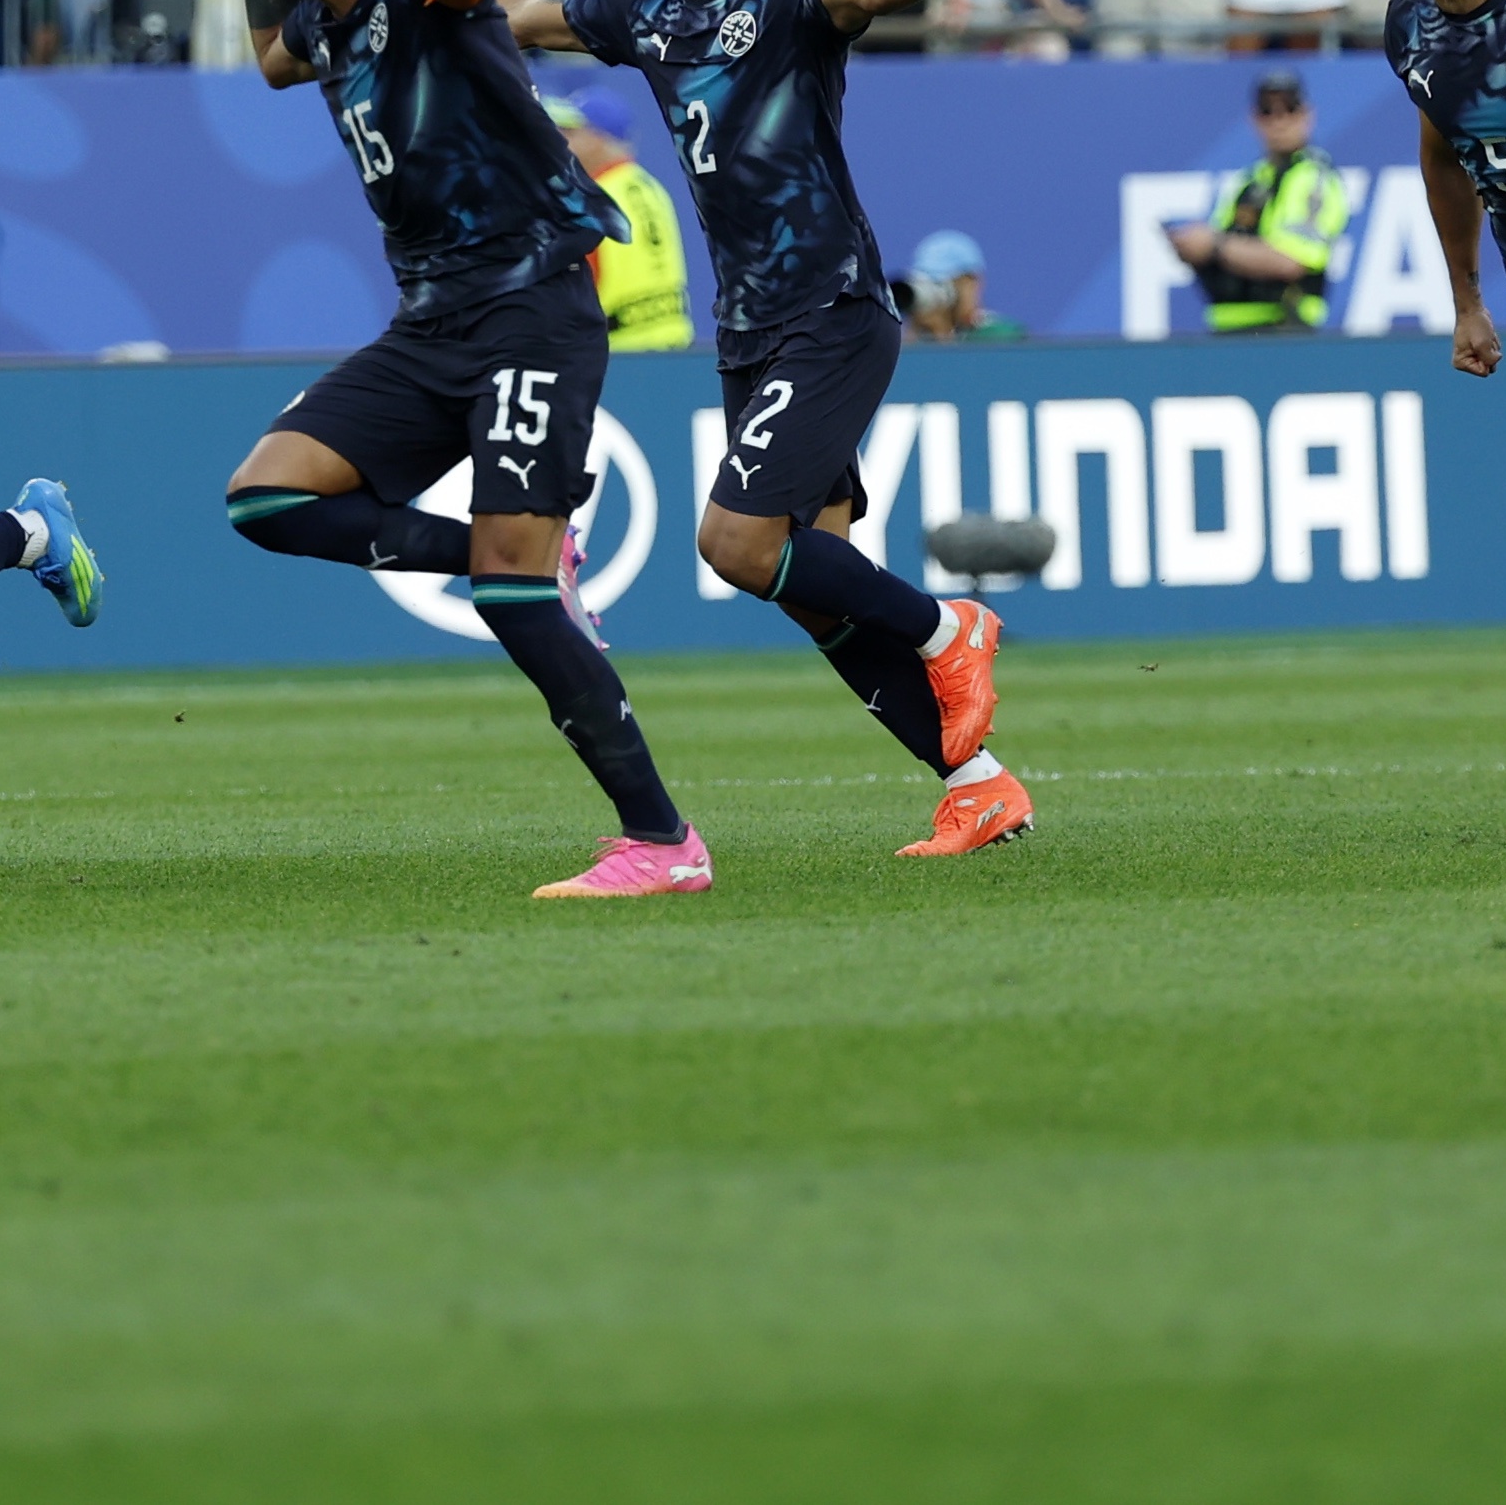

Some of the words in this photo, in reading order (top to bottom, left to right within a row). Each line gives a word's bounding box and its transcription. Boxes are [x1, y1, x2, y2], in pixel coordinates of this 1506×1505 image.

[343, 99, 395, 185] 15
[687, 99, 717, 175] 2
[1120, 166, 1461, 342] FA
[487, 369, 558, 446] 15
[740, 380, 794, 450] 2
